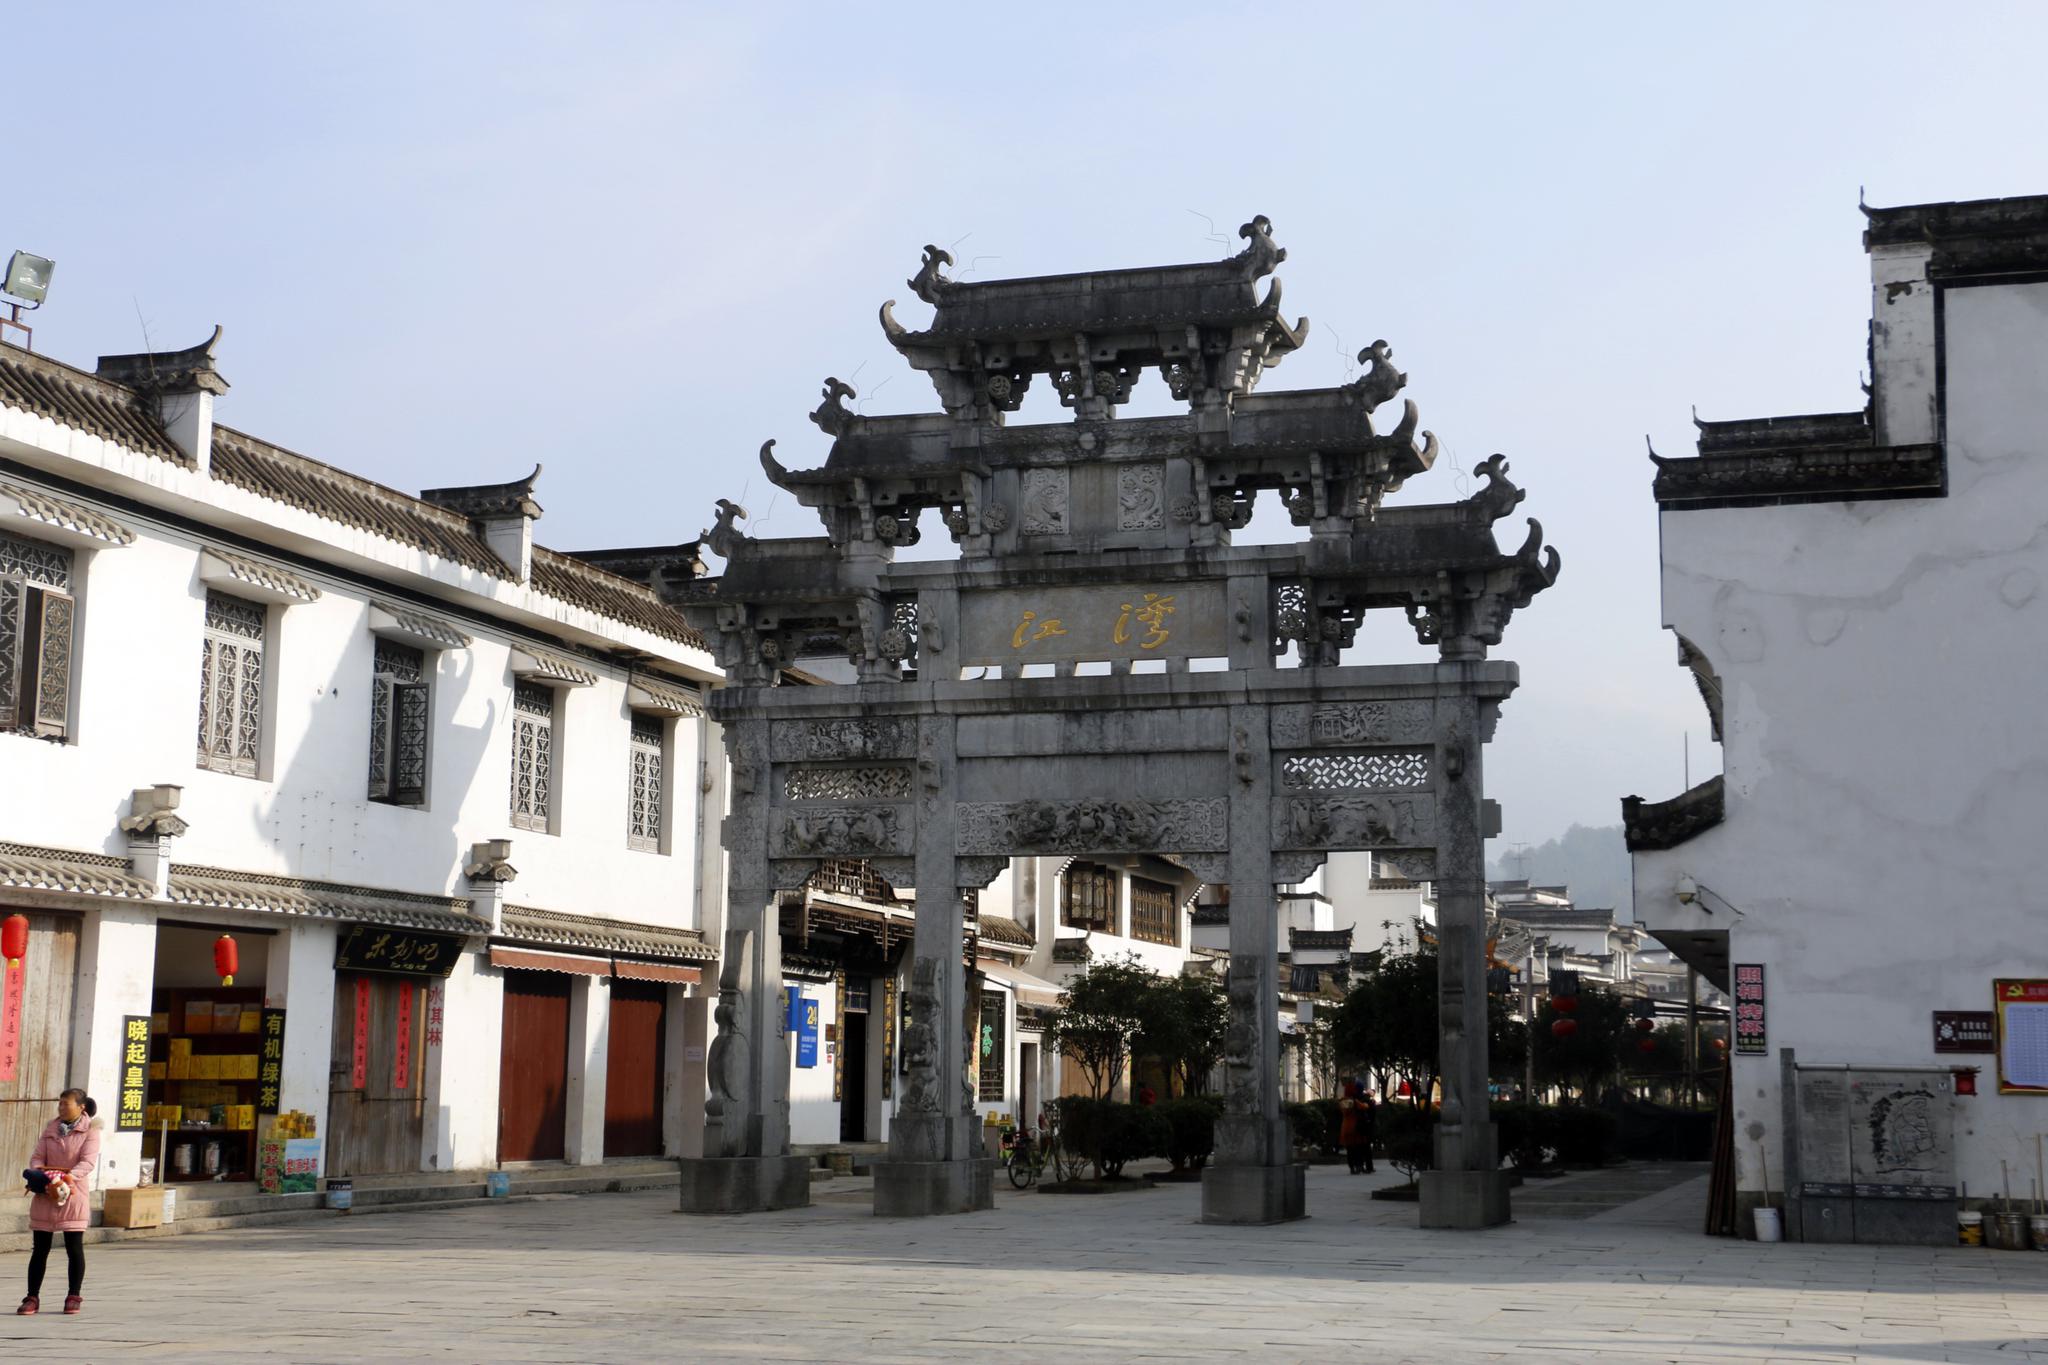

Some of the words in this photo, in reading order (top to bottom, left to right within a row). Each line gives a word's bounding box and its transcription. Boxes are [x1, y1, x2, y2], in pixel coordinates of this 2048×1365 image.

[1737, 966, 1763, 1036] 照相烤杯
[123, 1019, 148, 1111] 晓起皇菊
[261, 1013, 284, 1108] 有机绿茶
